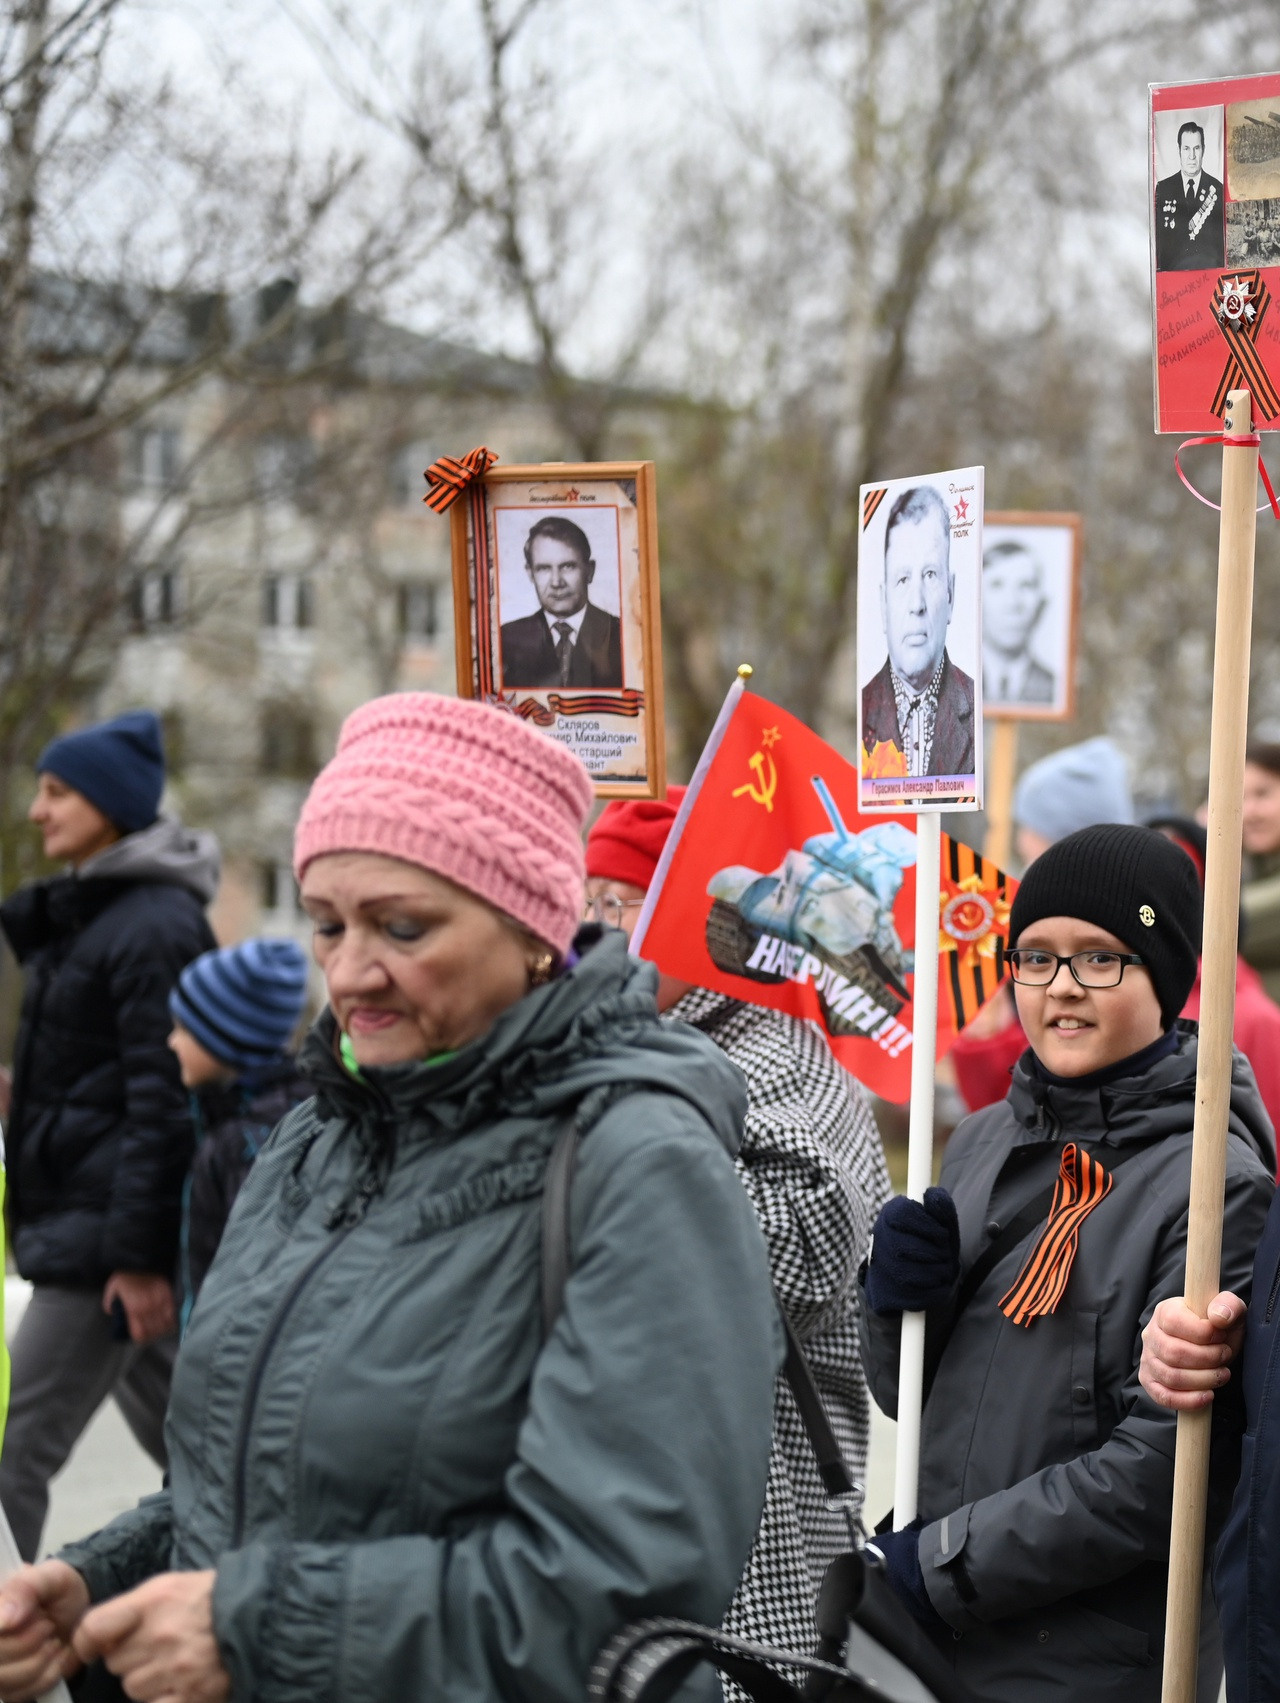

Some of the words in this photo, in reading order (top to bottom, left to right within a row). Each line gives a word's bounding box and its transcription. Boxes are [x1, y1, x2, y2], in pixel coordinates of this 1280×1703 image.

[557, 718, 600, 733] Скляров
[575, 731, 637, 744] Михайлович
[579, 745, 622, 758] старший
